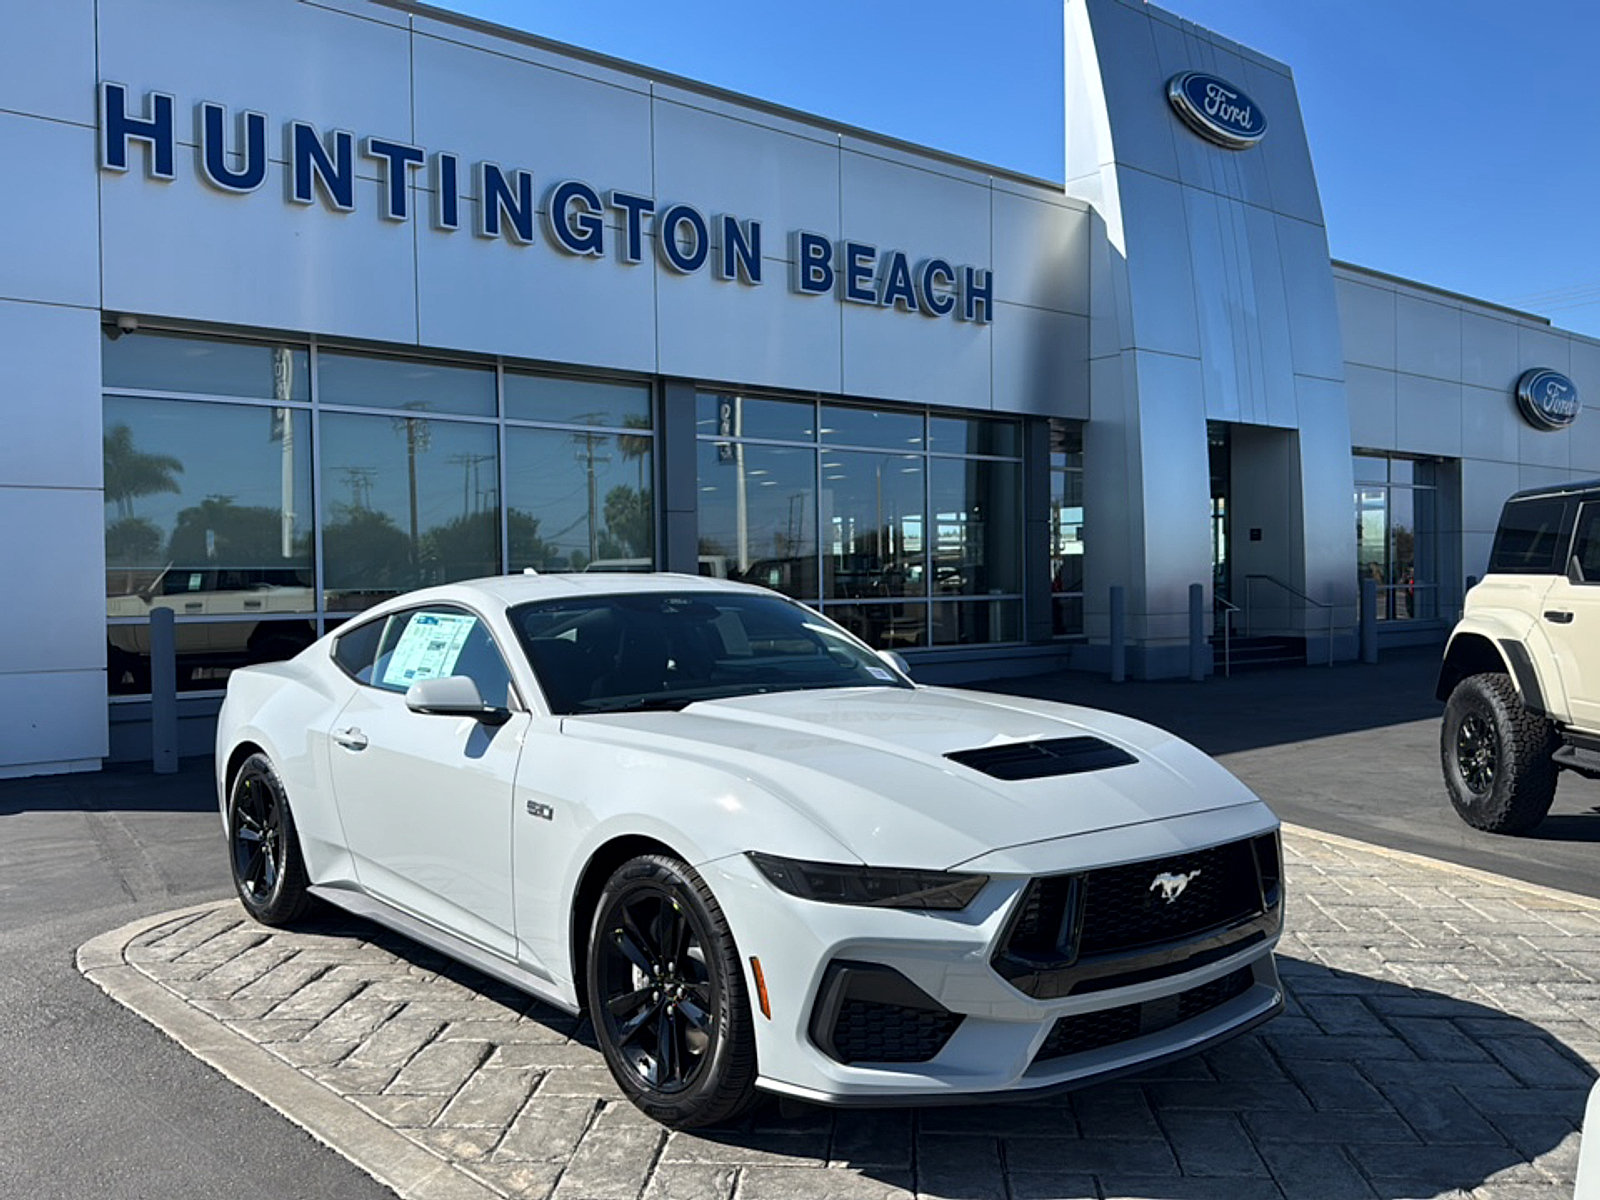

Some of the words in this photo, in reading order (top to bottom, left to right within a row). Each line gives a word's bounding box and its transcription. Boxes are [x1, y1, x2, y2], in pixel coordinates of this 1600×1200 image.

[1204, 83, 1253, 129] Ford
[101, 80, 763, 286] HUNTINGTON
[792, 229, 994, 323] BEACH
[1543, 381, 1576, 416] Ford
